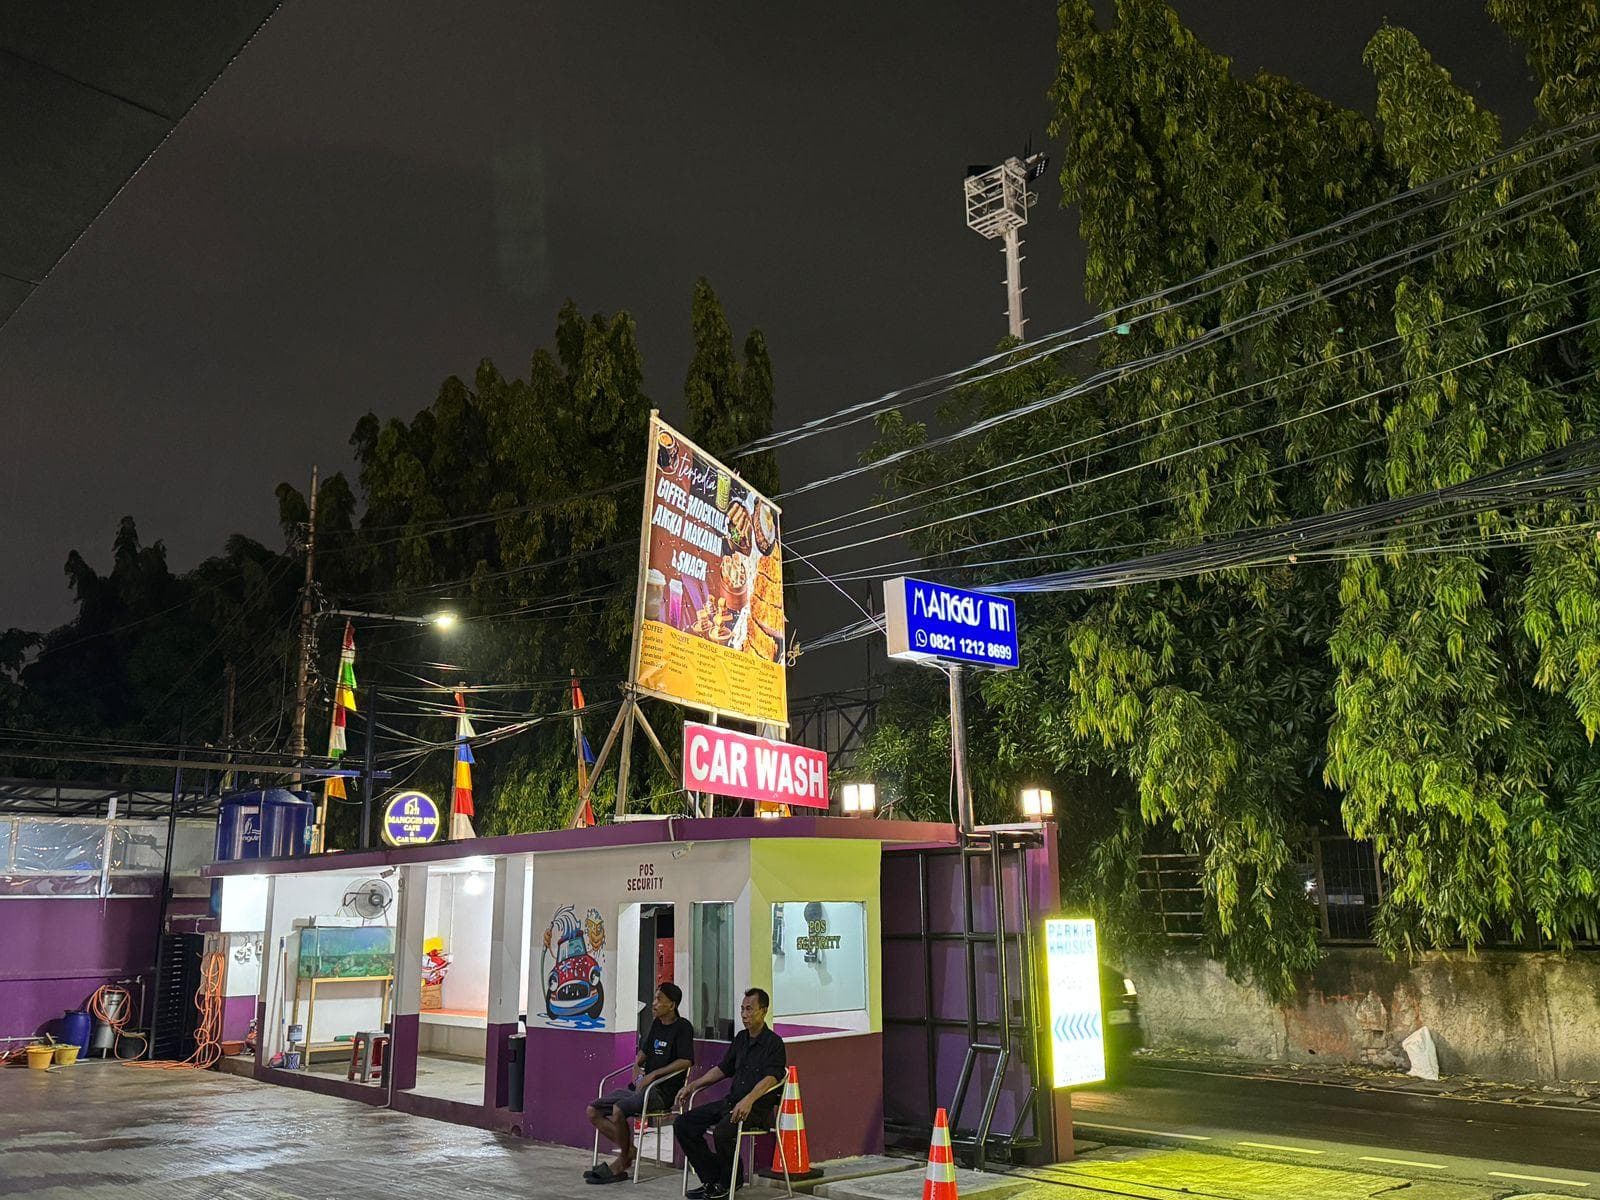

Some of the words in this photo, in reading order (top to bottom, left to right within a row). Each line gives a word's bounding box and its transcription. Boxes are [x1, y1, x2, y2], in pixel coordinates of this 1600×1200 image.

[677, 550, 707, 581] SNACK
[929, 633, 956, 651] 0821
[960, 637, 985, 656] 1212
[987, 643, 1012, 660] 8699
[689, 734, 748, 787] CAR
[754, 747, 825, 799] WASH
[639, 864, 654, 876] POS
[627, 877, 664, 891] SECURITY
[809, 920, 827, 933] POS
[797, 936, 841, 950] SECURITY
